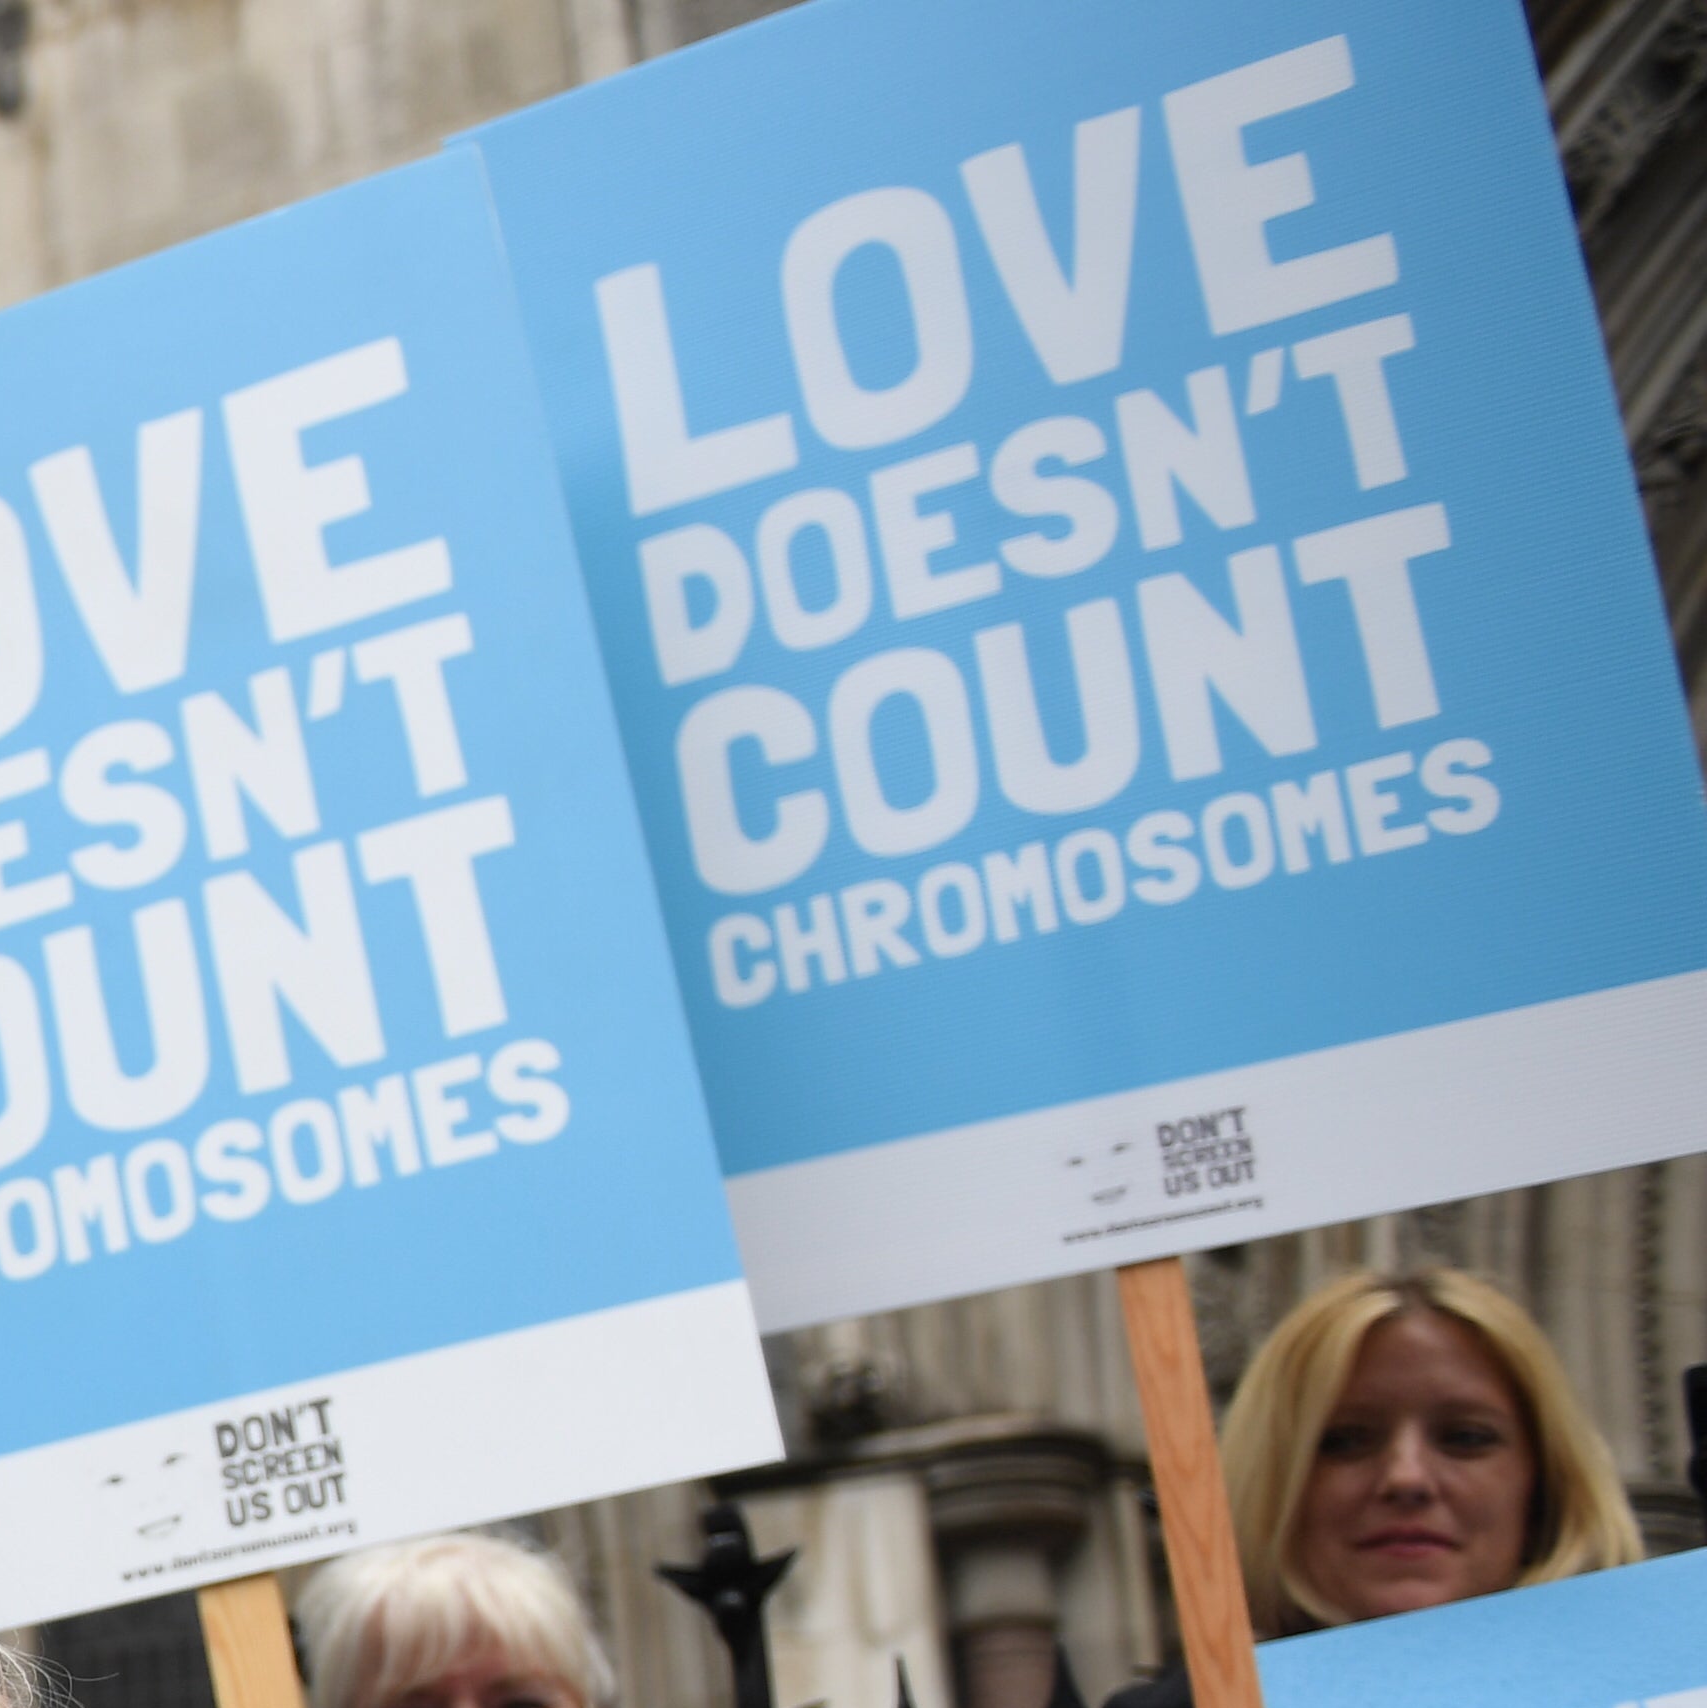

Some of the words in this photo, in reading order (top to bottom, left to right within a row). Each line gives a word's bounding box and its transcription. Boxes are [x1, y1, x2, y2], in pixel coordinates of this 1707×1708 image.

[592, 32, 1399, 517] LOVE
[636, 312, 1416, 688] DOESN'T
[674, 501, 1451, 898] COUNT
[707, 737, 1503, 1011] CHROMOSOMES
[215, 1397, 332, 1458] DON'T
[222, 1436, 342, 1490] SCREEN
[225, 1491, 271, 1527] US
[284, 1472, 347, 1515] OUT
